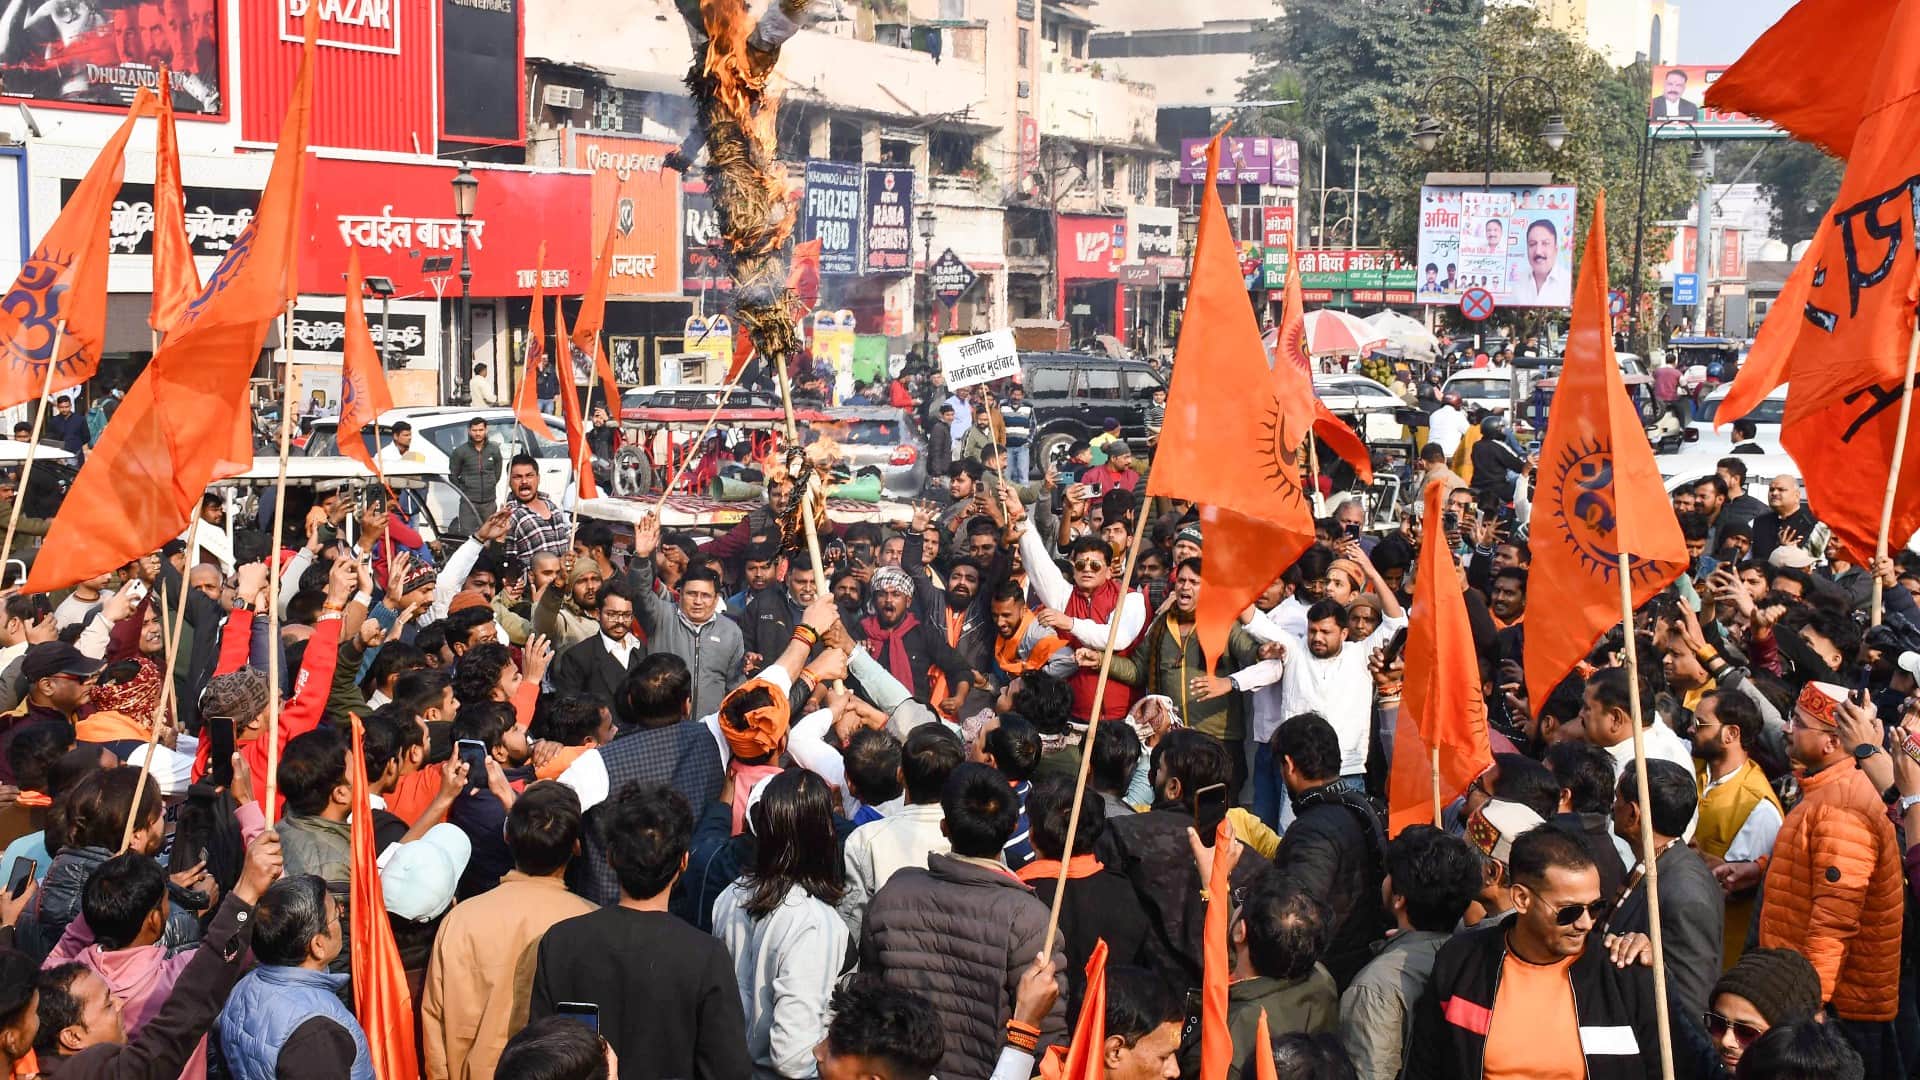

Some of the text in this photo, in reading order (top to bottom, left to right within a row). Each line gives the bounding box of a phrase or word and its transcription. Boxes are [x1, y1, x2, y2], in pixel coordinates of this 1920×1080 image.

[808, 188, 858, 219] FROZEN
[873, 205, 904, 226] RAMA
[1425, 208, 1459, 228] अमित
[337, 205, 411, 255] स्टाईल
[816, 219, 849, 250] FOOD
[1076, 231, 1110, 263] VIP
[949, 364, 986, 383] आतंकवाद
